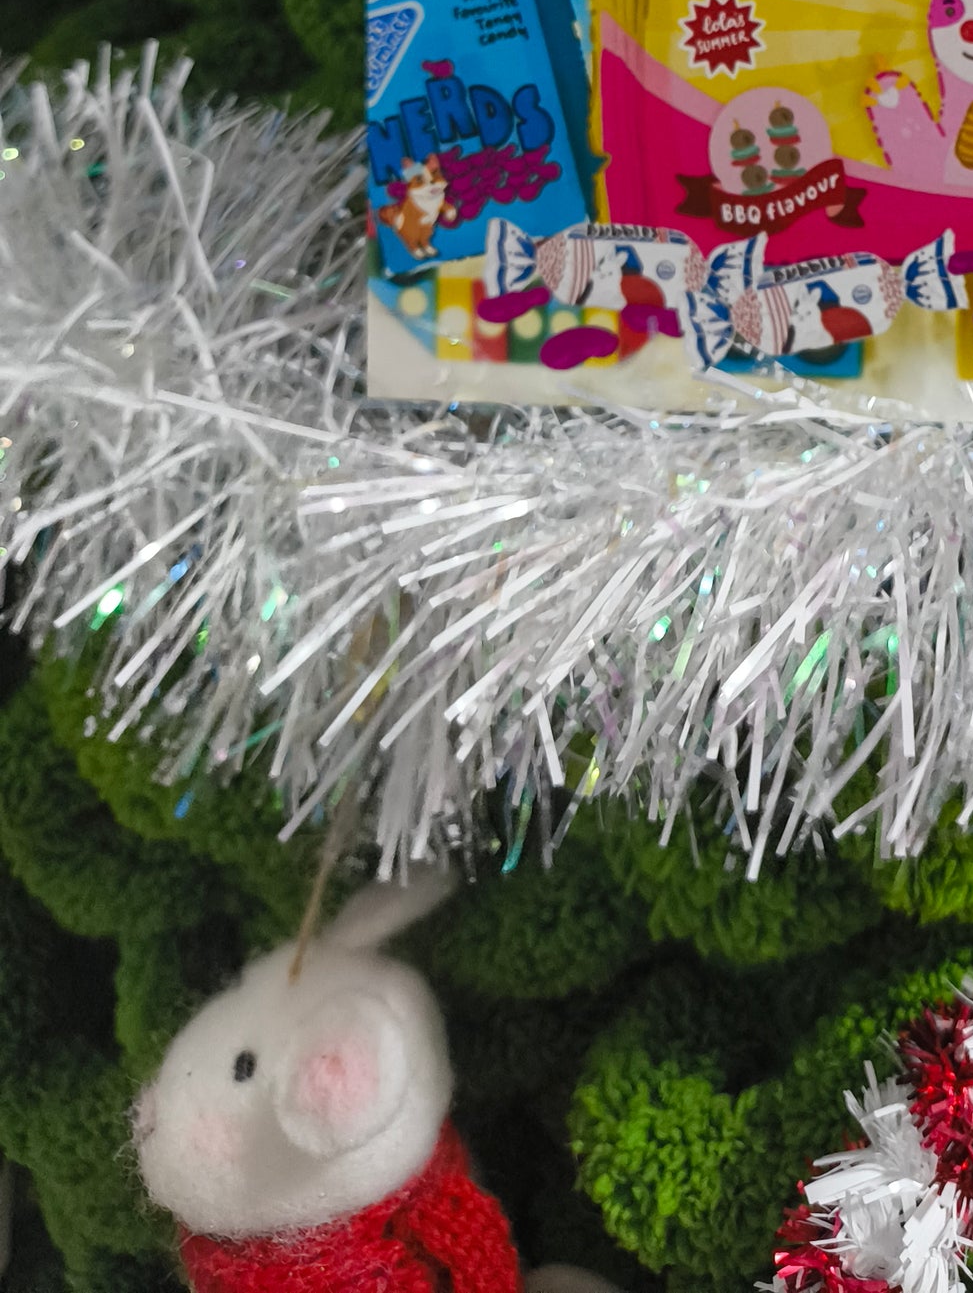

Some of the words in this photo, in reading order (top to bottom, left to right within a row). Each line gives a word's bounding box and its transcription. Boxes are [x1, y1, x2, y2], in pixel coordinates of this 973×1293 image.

[696, 31, 751, 55] SUMMER
[366, 75, 555, 187] NERDS
[720, 203, 761, 224] BBQ
[765, 173, 840, 221] flavour
